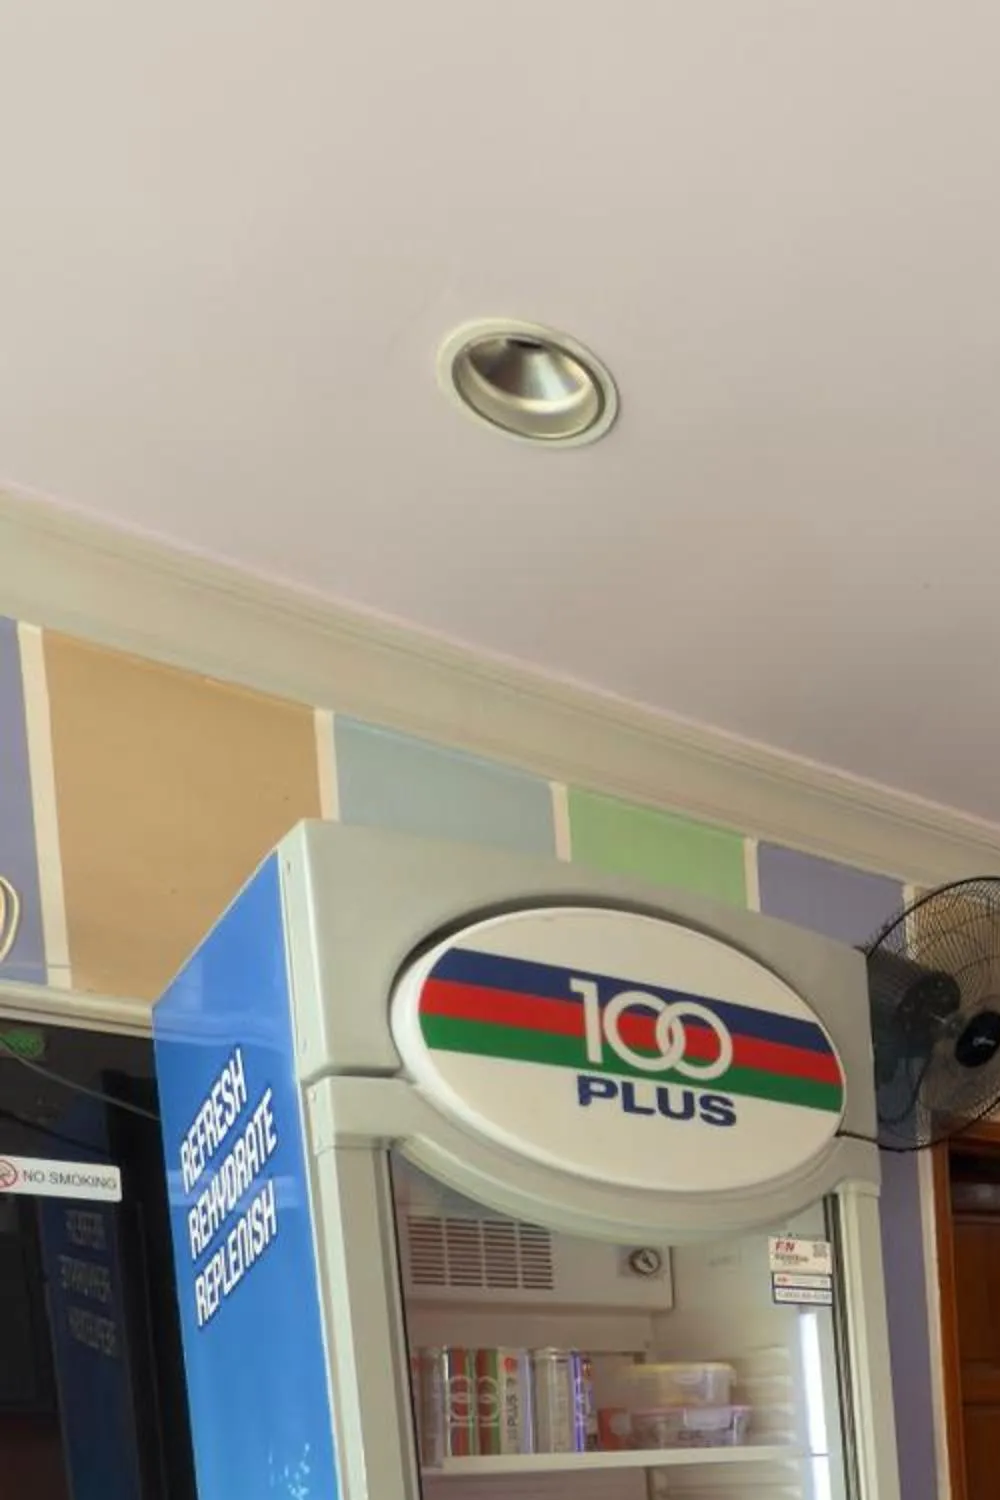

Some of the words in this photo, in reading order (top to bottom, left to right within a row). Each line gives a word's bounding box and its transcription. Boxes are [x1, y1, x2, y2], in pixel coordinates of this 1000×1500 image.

[569, 978, 733, 1080] 100
[180, 1047, 247, 1193] REFRESH
[576, 1075, 736, 1127] PLUS
[23, 1168, 45, 1184] NO
[48, 1171, 118, 1191] SMOKING
[188, 1087, 277, 1260] REHYDRATE
[194, 1179, 277, 1327] REPLENISH
